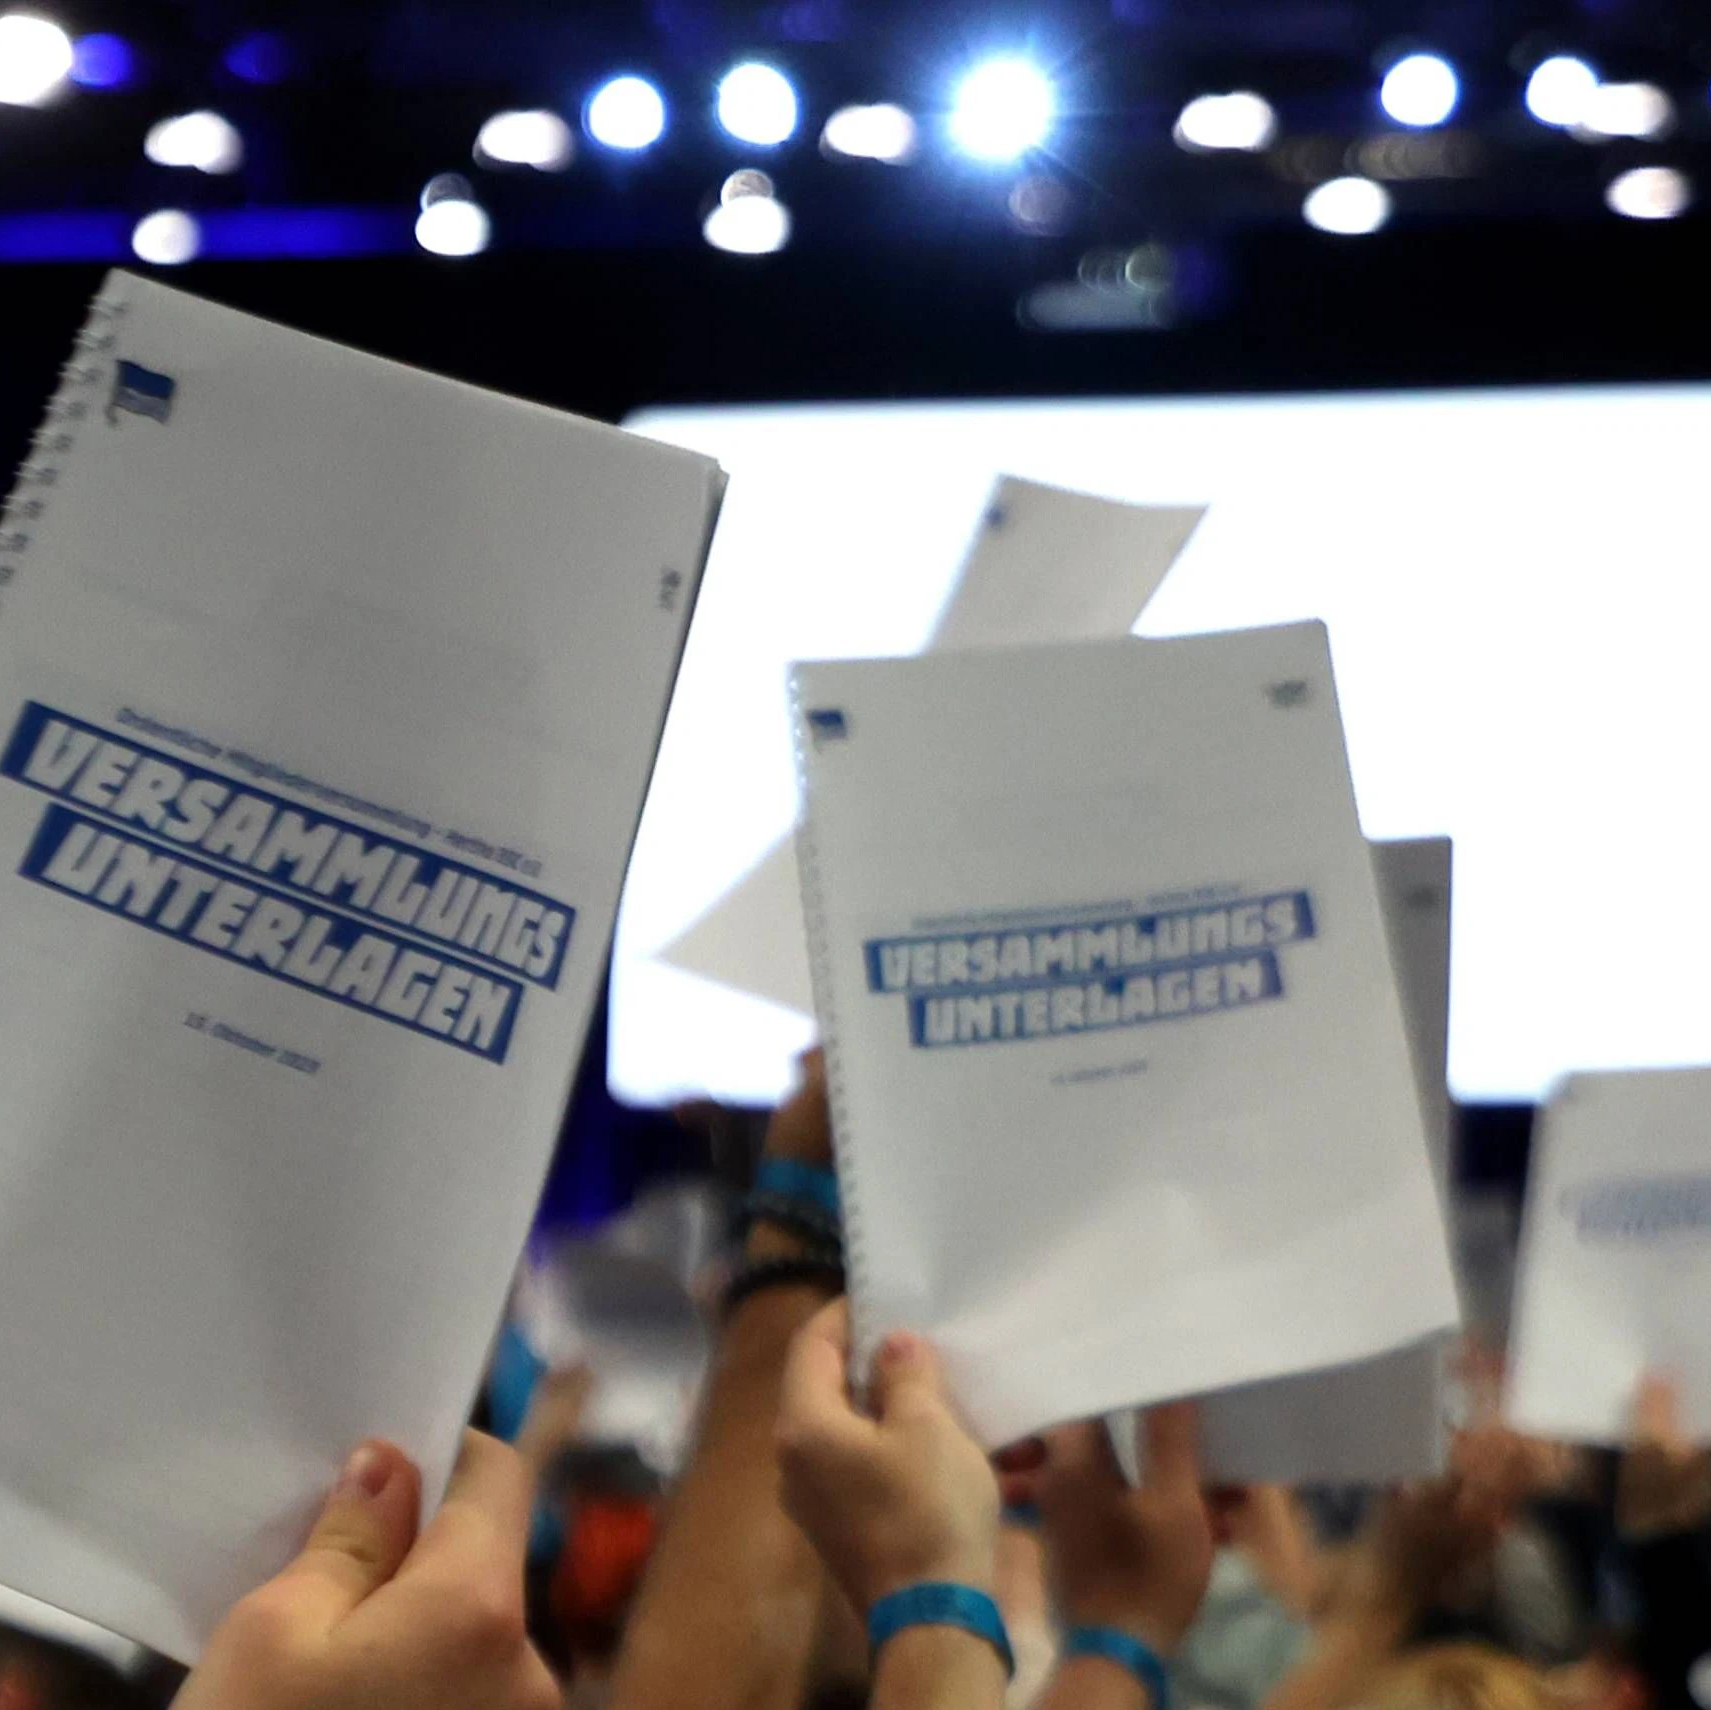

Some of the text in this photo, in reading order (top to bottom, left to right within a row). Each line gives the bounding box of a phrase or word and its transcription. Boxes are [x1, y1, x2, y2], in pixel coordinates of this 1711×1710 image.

[23, 717, 567, 979] VERSAMMLUNGS
[41, 822, 512, 1051] UNTERLAGEN
[878, 898, 1296, 989] VERSAMMLUNGS
[925, 957, 1264, 1045] UNTERLAGEN
